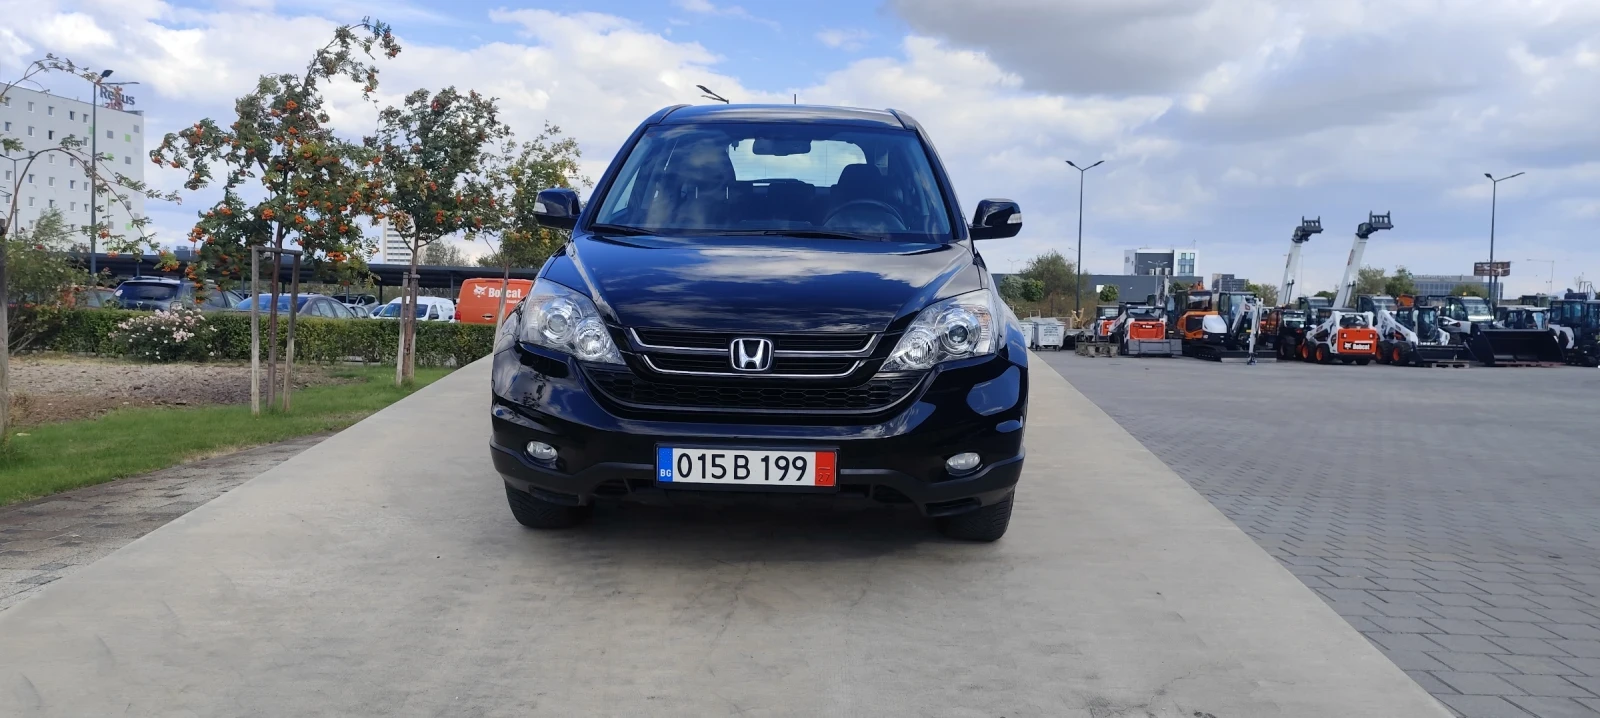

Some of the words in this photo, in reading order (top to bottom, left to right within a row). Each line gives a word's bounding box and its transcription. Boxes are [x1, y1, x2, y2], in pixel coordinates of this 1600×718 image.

[100, 86, 135, 105] Reus
[660, 469, 672, 477] BG
[760, 455, 808, 482] 199
